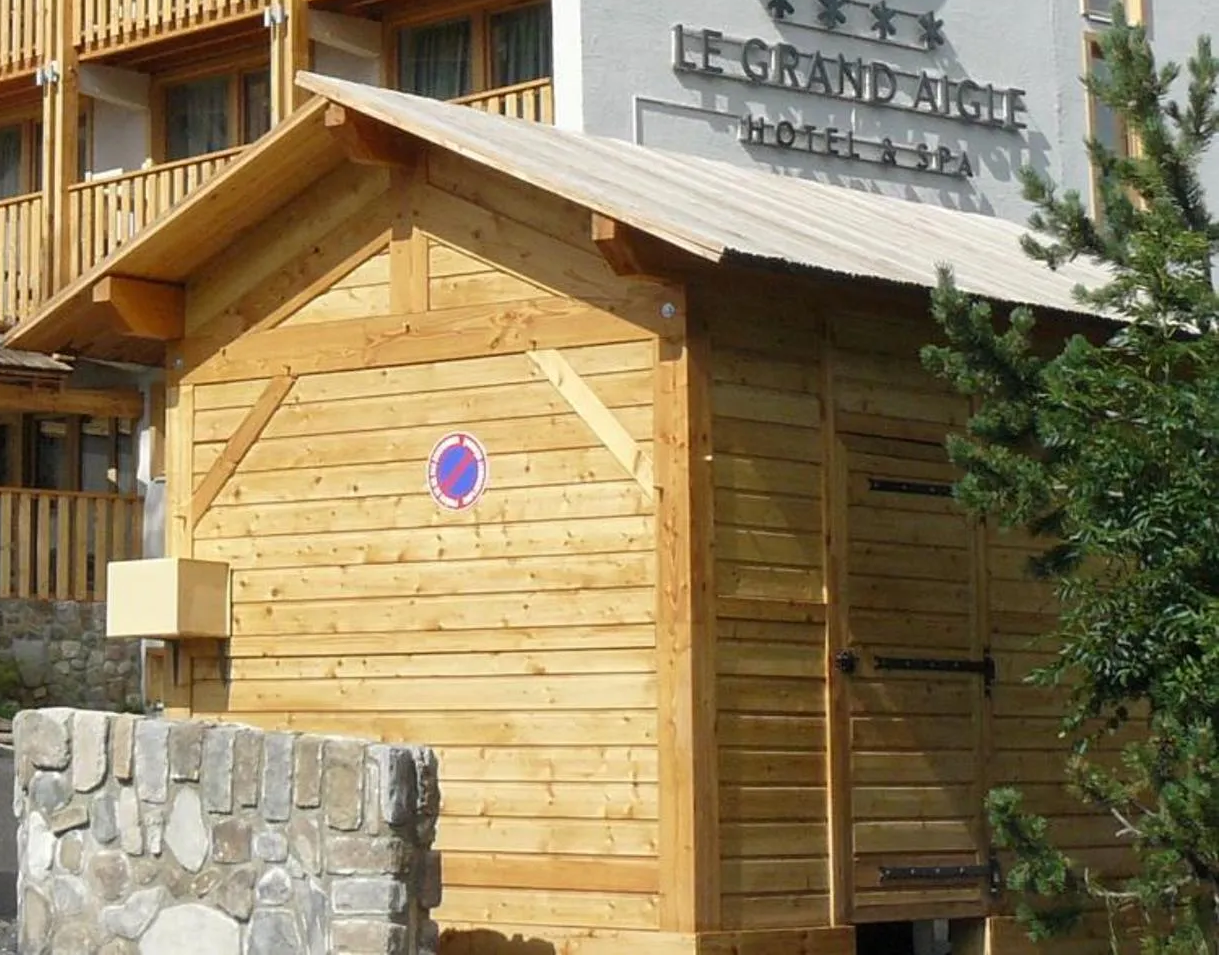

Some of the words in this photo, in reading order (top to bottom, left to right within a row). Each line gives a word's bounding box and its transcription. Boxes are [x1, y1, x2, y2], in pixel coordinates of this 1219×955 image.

[675, 23, 723, 74] LE
[741, 38, 896, 104] GRAND
[913, 71, 1028, 130] AIGLE
[747, 114, 860, 159] HOTEL
[881, 137, 898, 167] &
[916, 143, 974, 177] SPA
